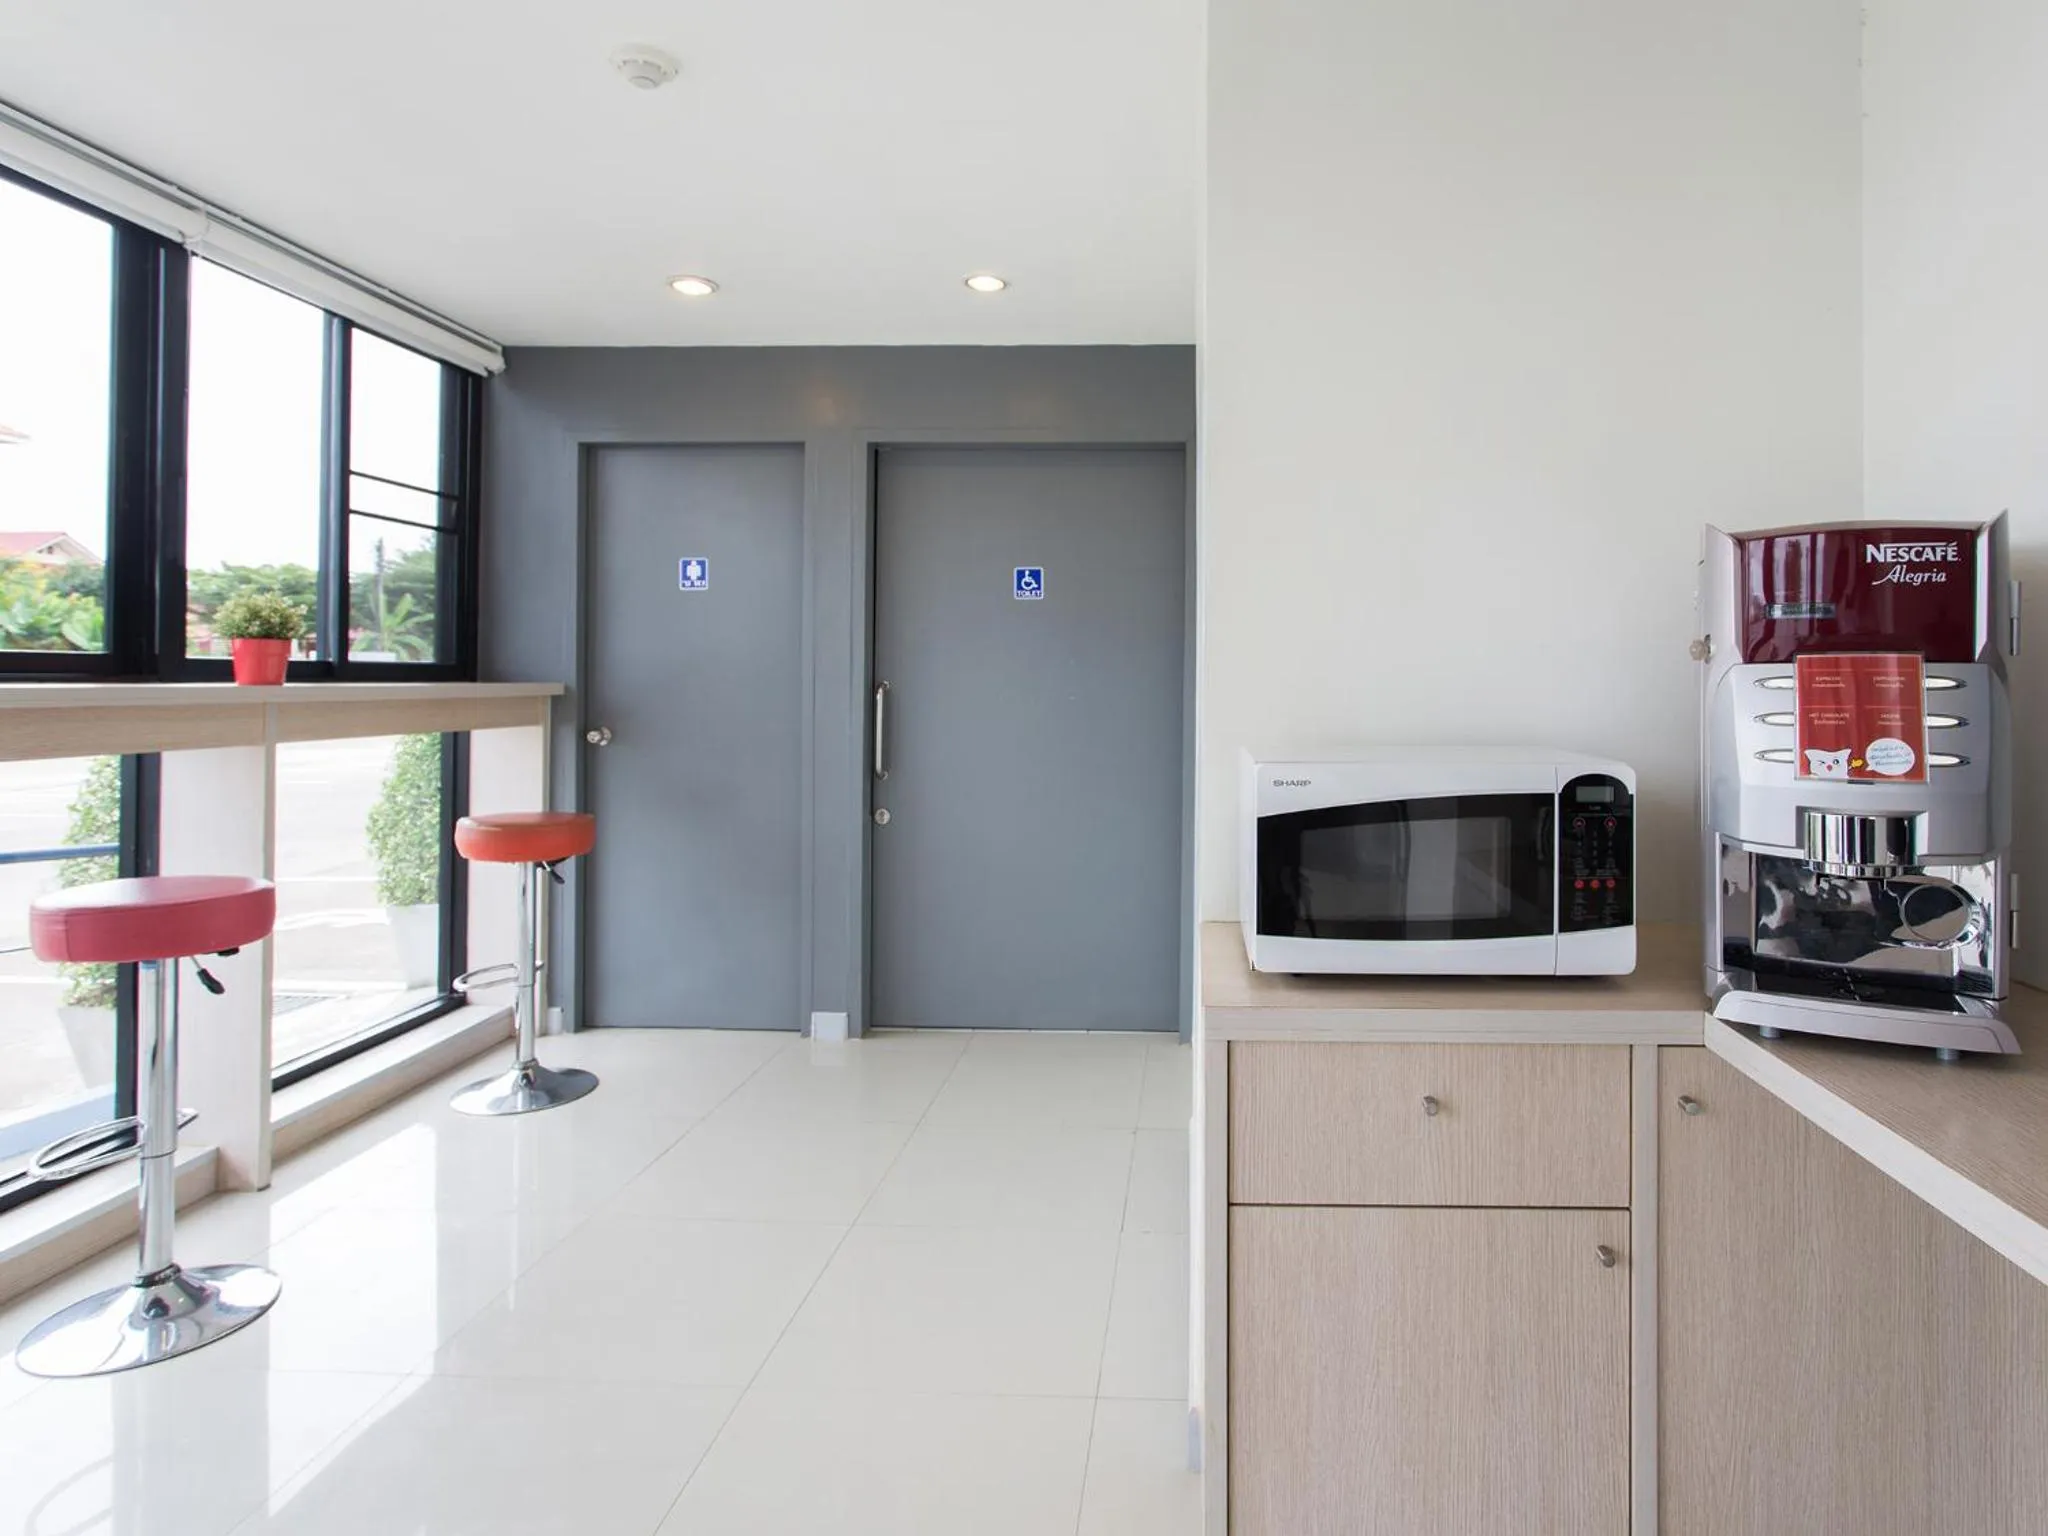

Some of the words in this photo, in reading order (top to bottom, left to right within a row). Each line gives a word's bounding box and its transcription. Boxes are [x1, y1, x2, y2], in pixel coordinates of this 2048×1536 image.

[1866, 541, 1958, 563] NESCAFÉ
[1872, 564, 1947, 586] Alegria
[1273, 779, 1312, 787] SHARP
